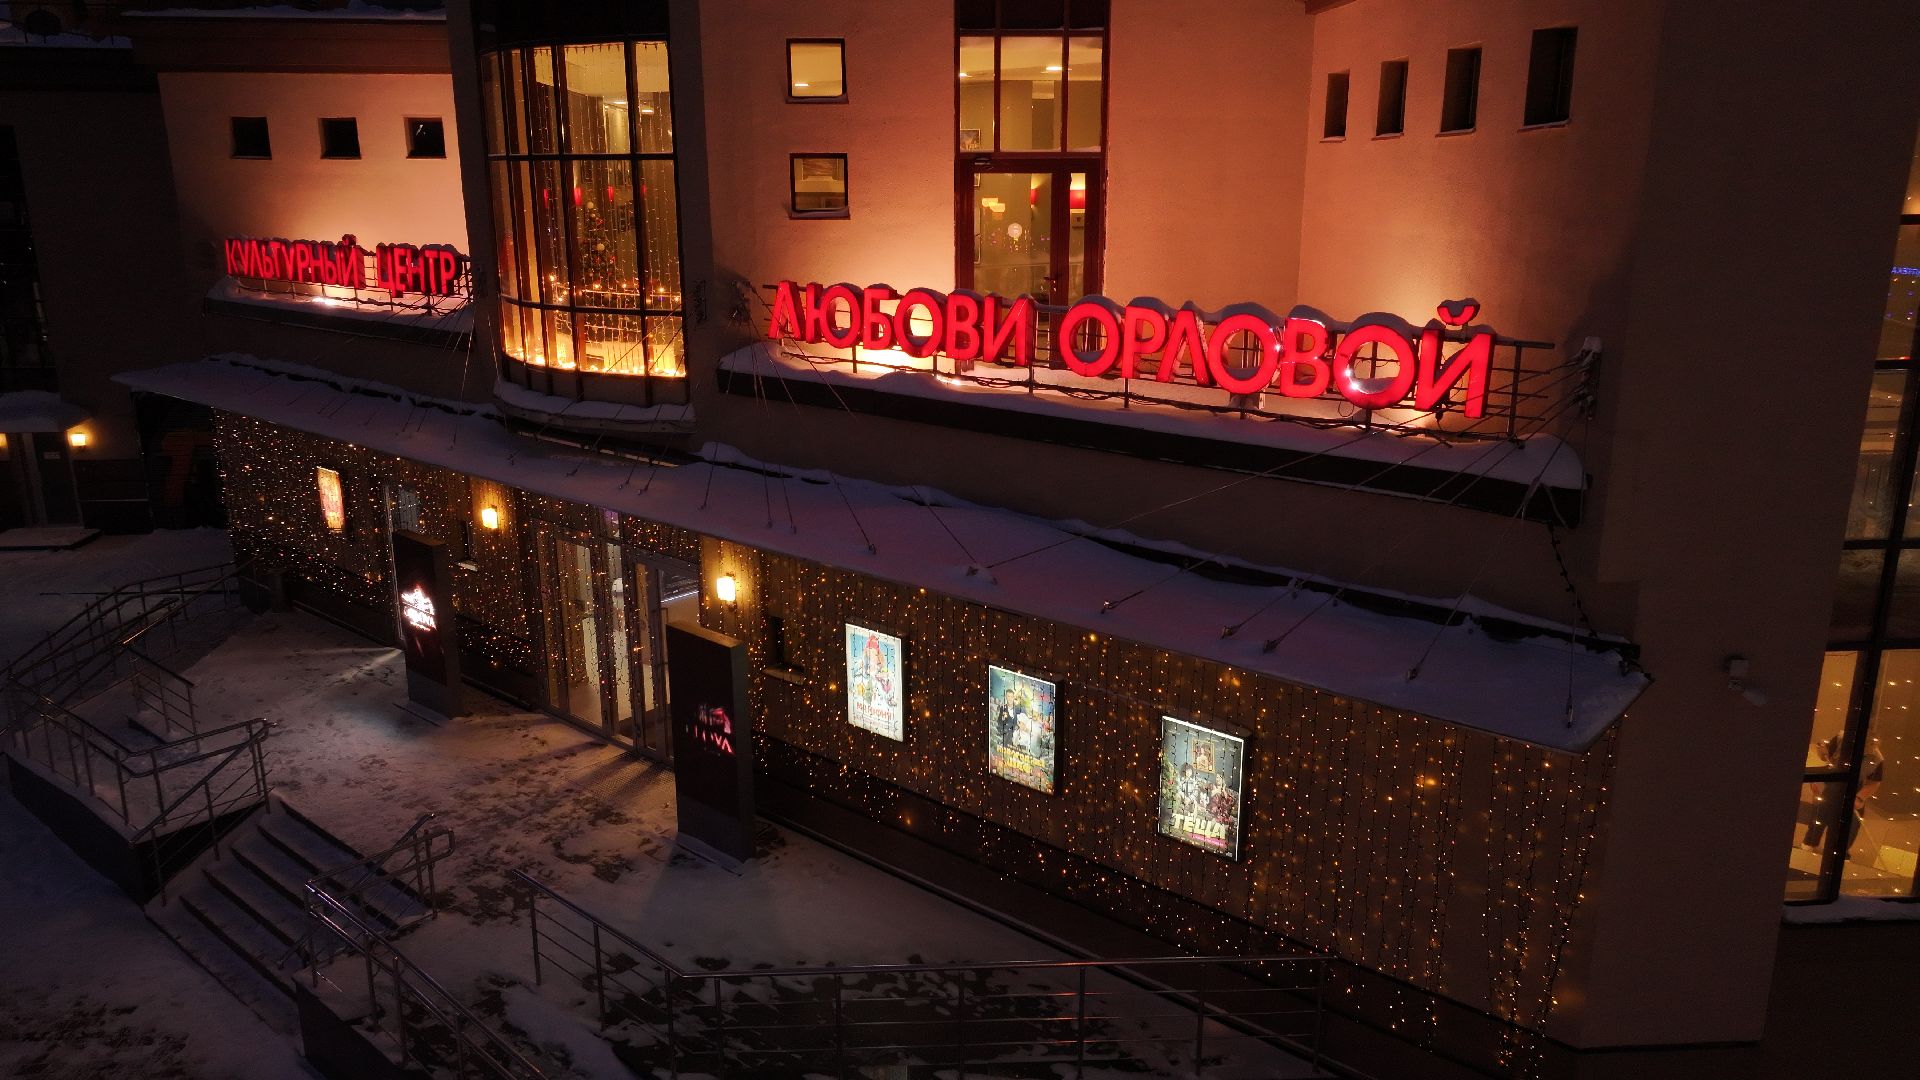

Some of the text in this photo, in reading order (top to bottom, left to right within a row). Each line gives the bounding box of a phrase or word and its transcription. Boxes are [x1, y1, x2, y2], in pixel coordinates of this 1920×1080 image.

[225, 235, 456, 298] КУЛЬТУРНЫЙ ЦЕНТР
[768, 280, 1494, 420] ЛЮБОВИ ОРЛОВОЙ
